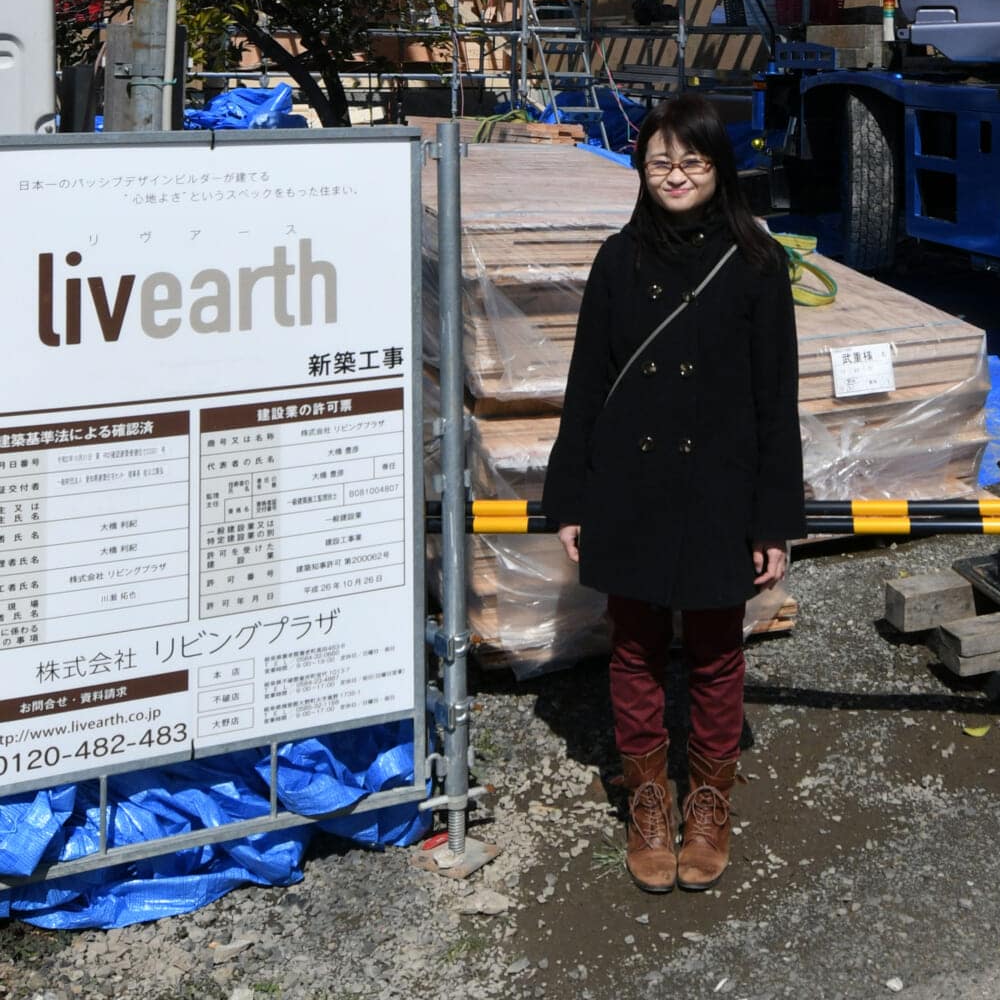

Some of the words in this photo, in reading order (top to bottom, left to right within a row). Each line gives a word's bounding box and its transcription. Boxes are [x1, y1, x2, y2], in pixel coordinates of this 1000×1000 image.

[38, 238, 338, 347] livearth
[308, 346, 404, 378] 新築工事
[256, 399, 353, 422] 建設業の許可票
[69, 572, 104, 584] 株式会社
[108, 562, 167, 578] リビングプラザ
[36, 647, 138, 684] 株式会社
[155, 607, 341, 664] リビングプラザ
[19, 686, 128, 714] お問合せ・資料請求
[212, 716, 239, 729] 大野店
